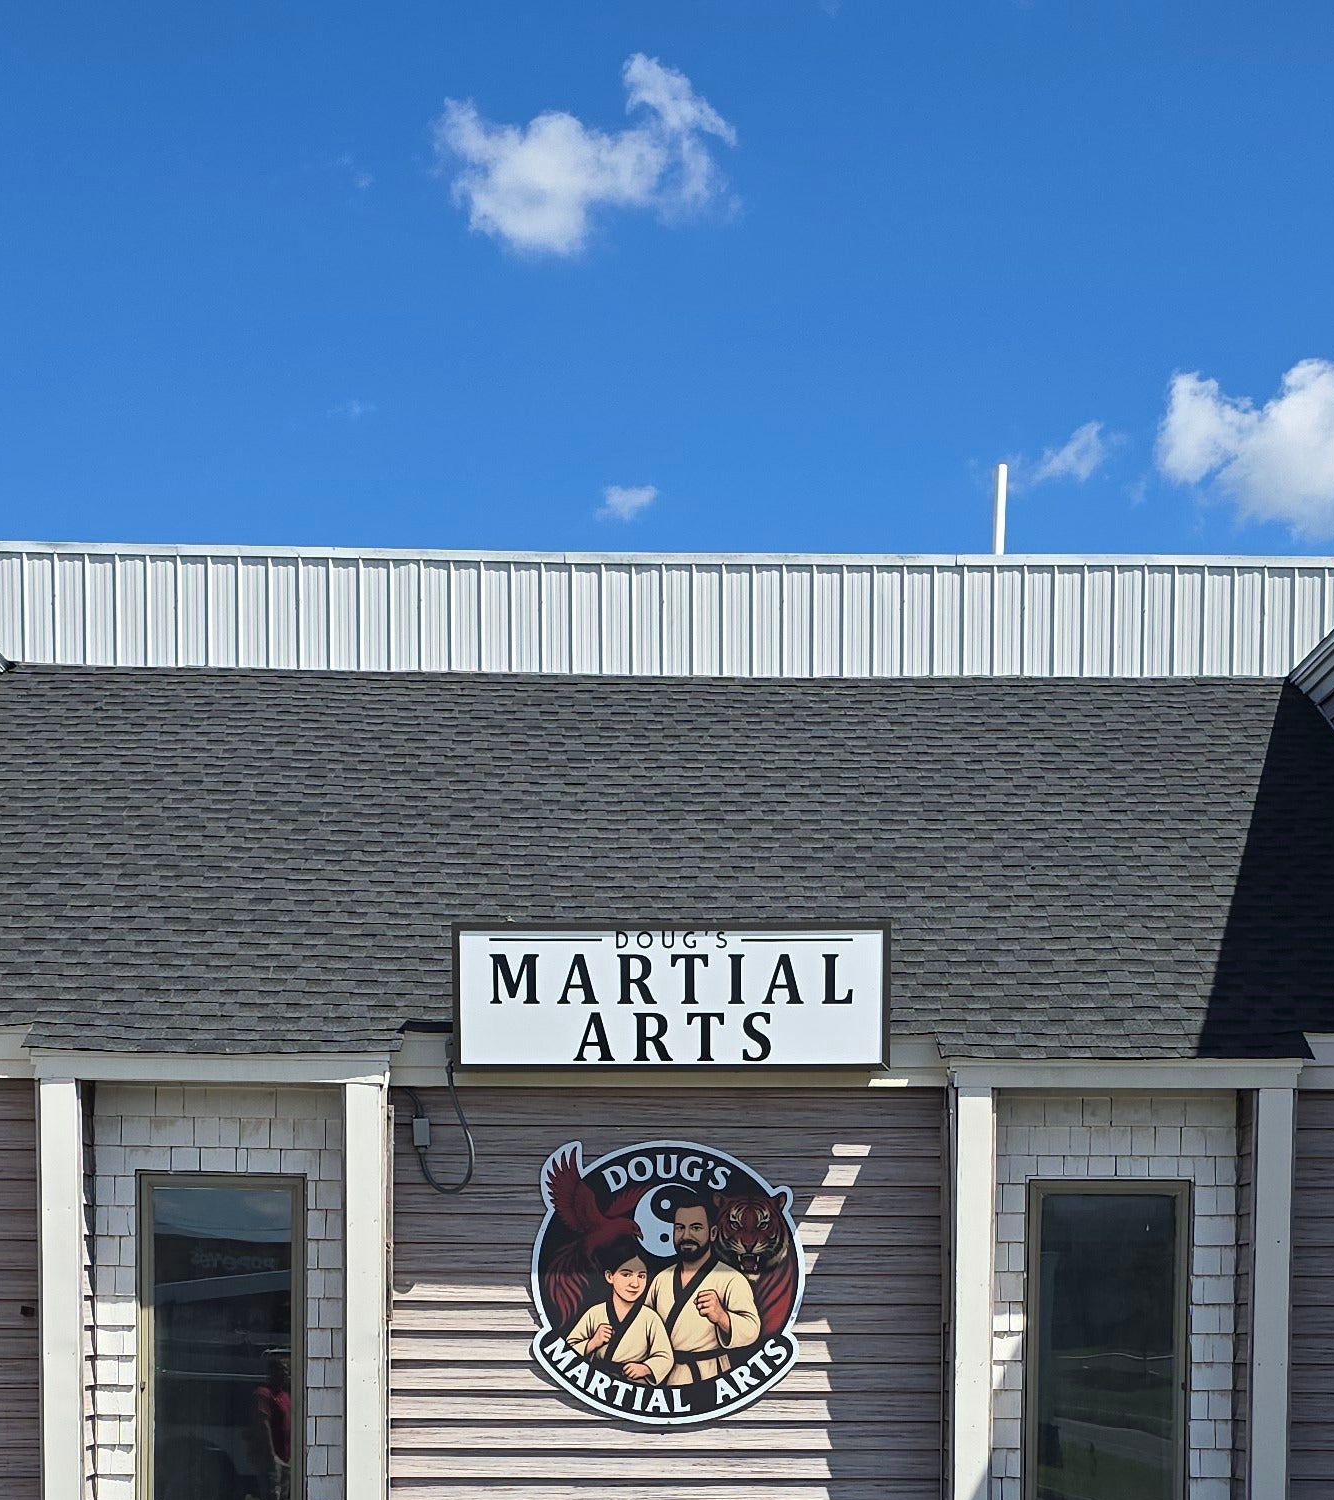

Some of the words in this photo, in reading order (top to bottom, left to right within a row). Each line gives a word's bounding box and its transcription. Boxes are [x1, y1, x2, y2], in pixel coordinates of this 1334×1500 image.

[615, 931, 728, 949] DOUG'S
[489, 953, 854, 1005] MARTIAL
[573, 1011, 772, 1062] ARTS
[601, 1154, 732, 1193] DOUG'S
[543, 1336, 691, 1413] MARTIAL
[714, 1338, 787, 1405] ARTS
